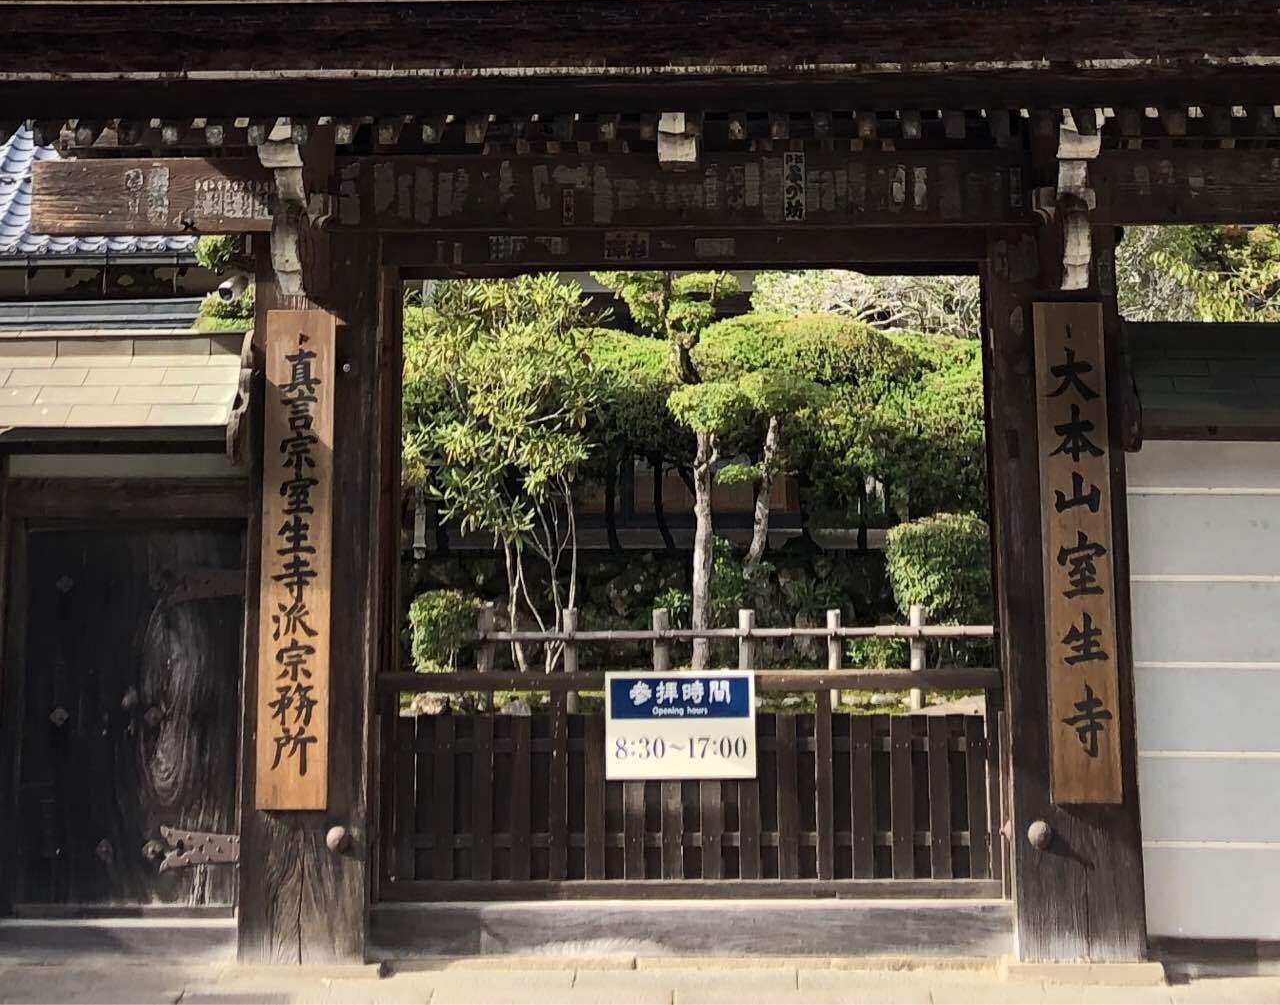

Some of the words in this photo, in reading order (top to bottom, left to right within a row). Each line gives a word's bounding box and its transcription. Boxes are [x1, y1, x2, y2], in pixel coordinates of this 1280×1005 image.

[269, 347, 322, 776] 真言宗室生寺派宗務所
[1048, 347, 1113, 759] 大本山室生寺
[629, 680, 731, 706] 参拝時間
[652, 707, 684, 717] Opening
[686, 707, 708, 716] hours
